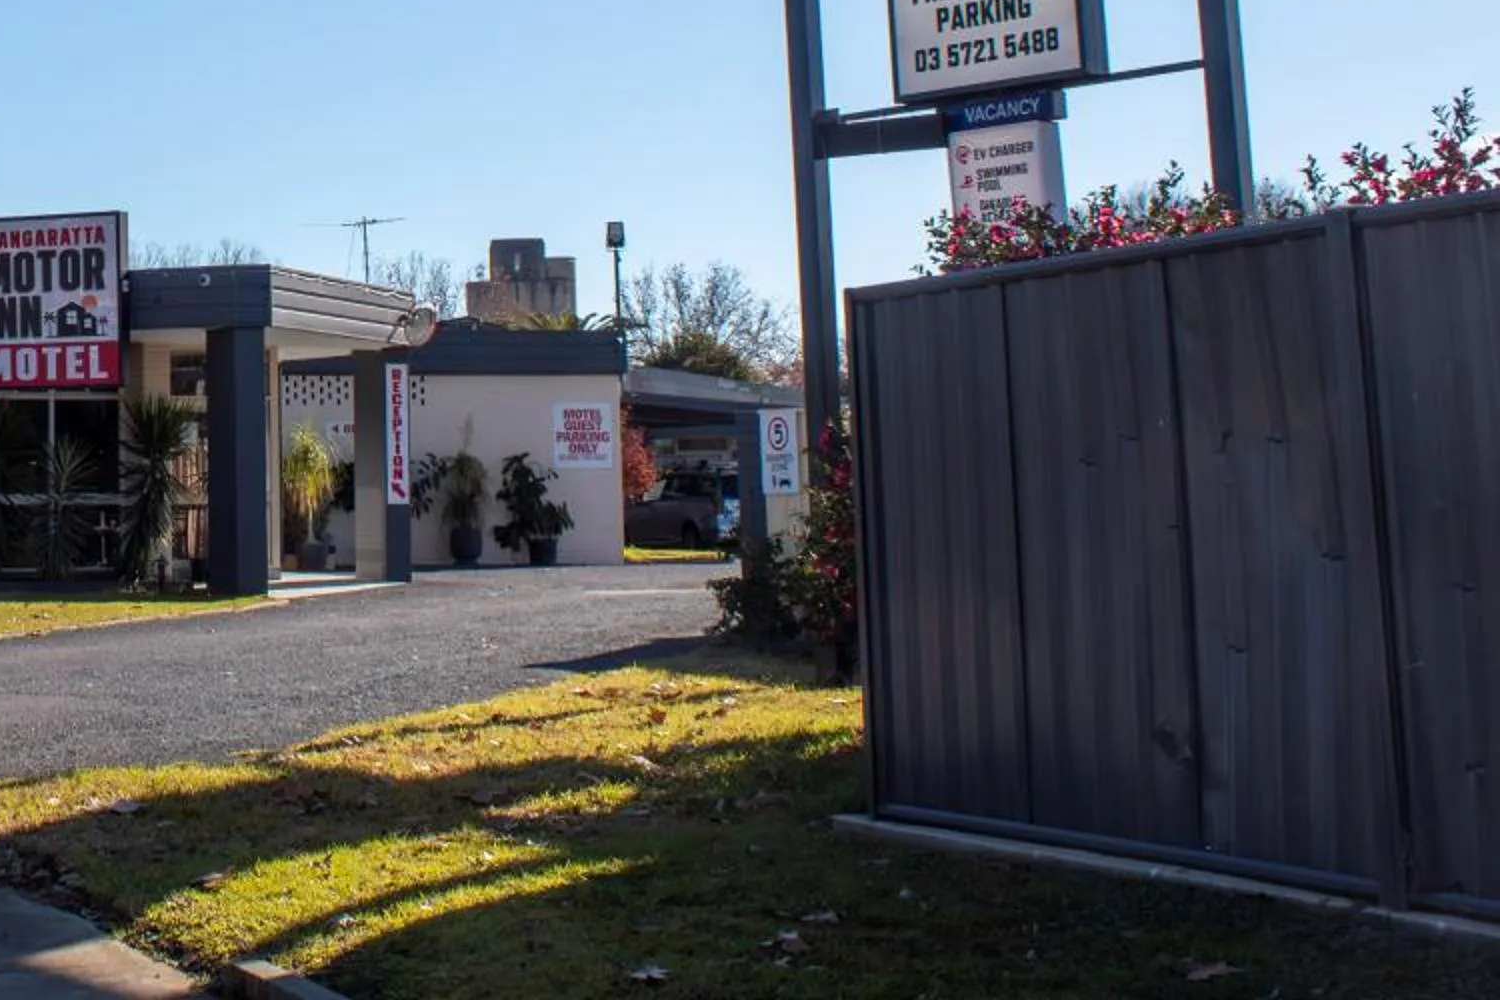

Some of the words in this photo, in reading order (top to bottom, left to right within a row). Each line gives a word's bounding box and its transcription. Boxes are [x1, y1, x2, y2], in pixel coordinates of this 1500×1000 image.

[914, 47, 941, 73] 03
[947, 37, 998, 68] 5721
[1004, 27, 1060, 59] 5488
[964, 97, 1041, 123] VACANCY
[974, 148, 986, 161] EV
[989, 141, 1035, 159] CHARGER
[976, 162, 1029, 181] SWIMMING
[391, 368, 403, 480] RECEPTION
[563, 408, 602, 420] MOTEL
[556, 431, 611, 442] PARKING
[774, 423, 784, 445] 5
[568, 443, 600, 454] ONLY
